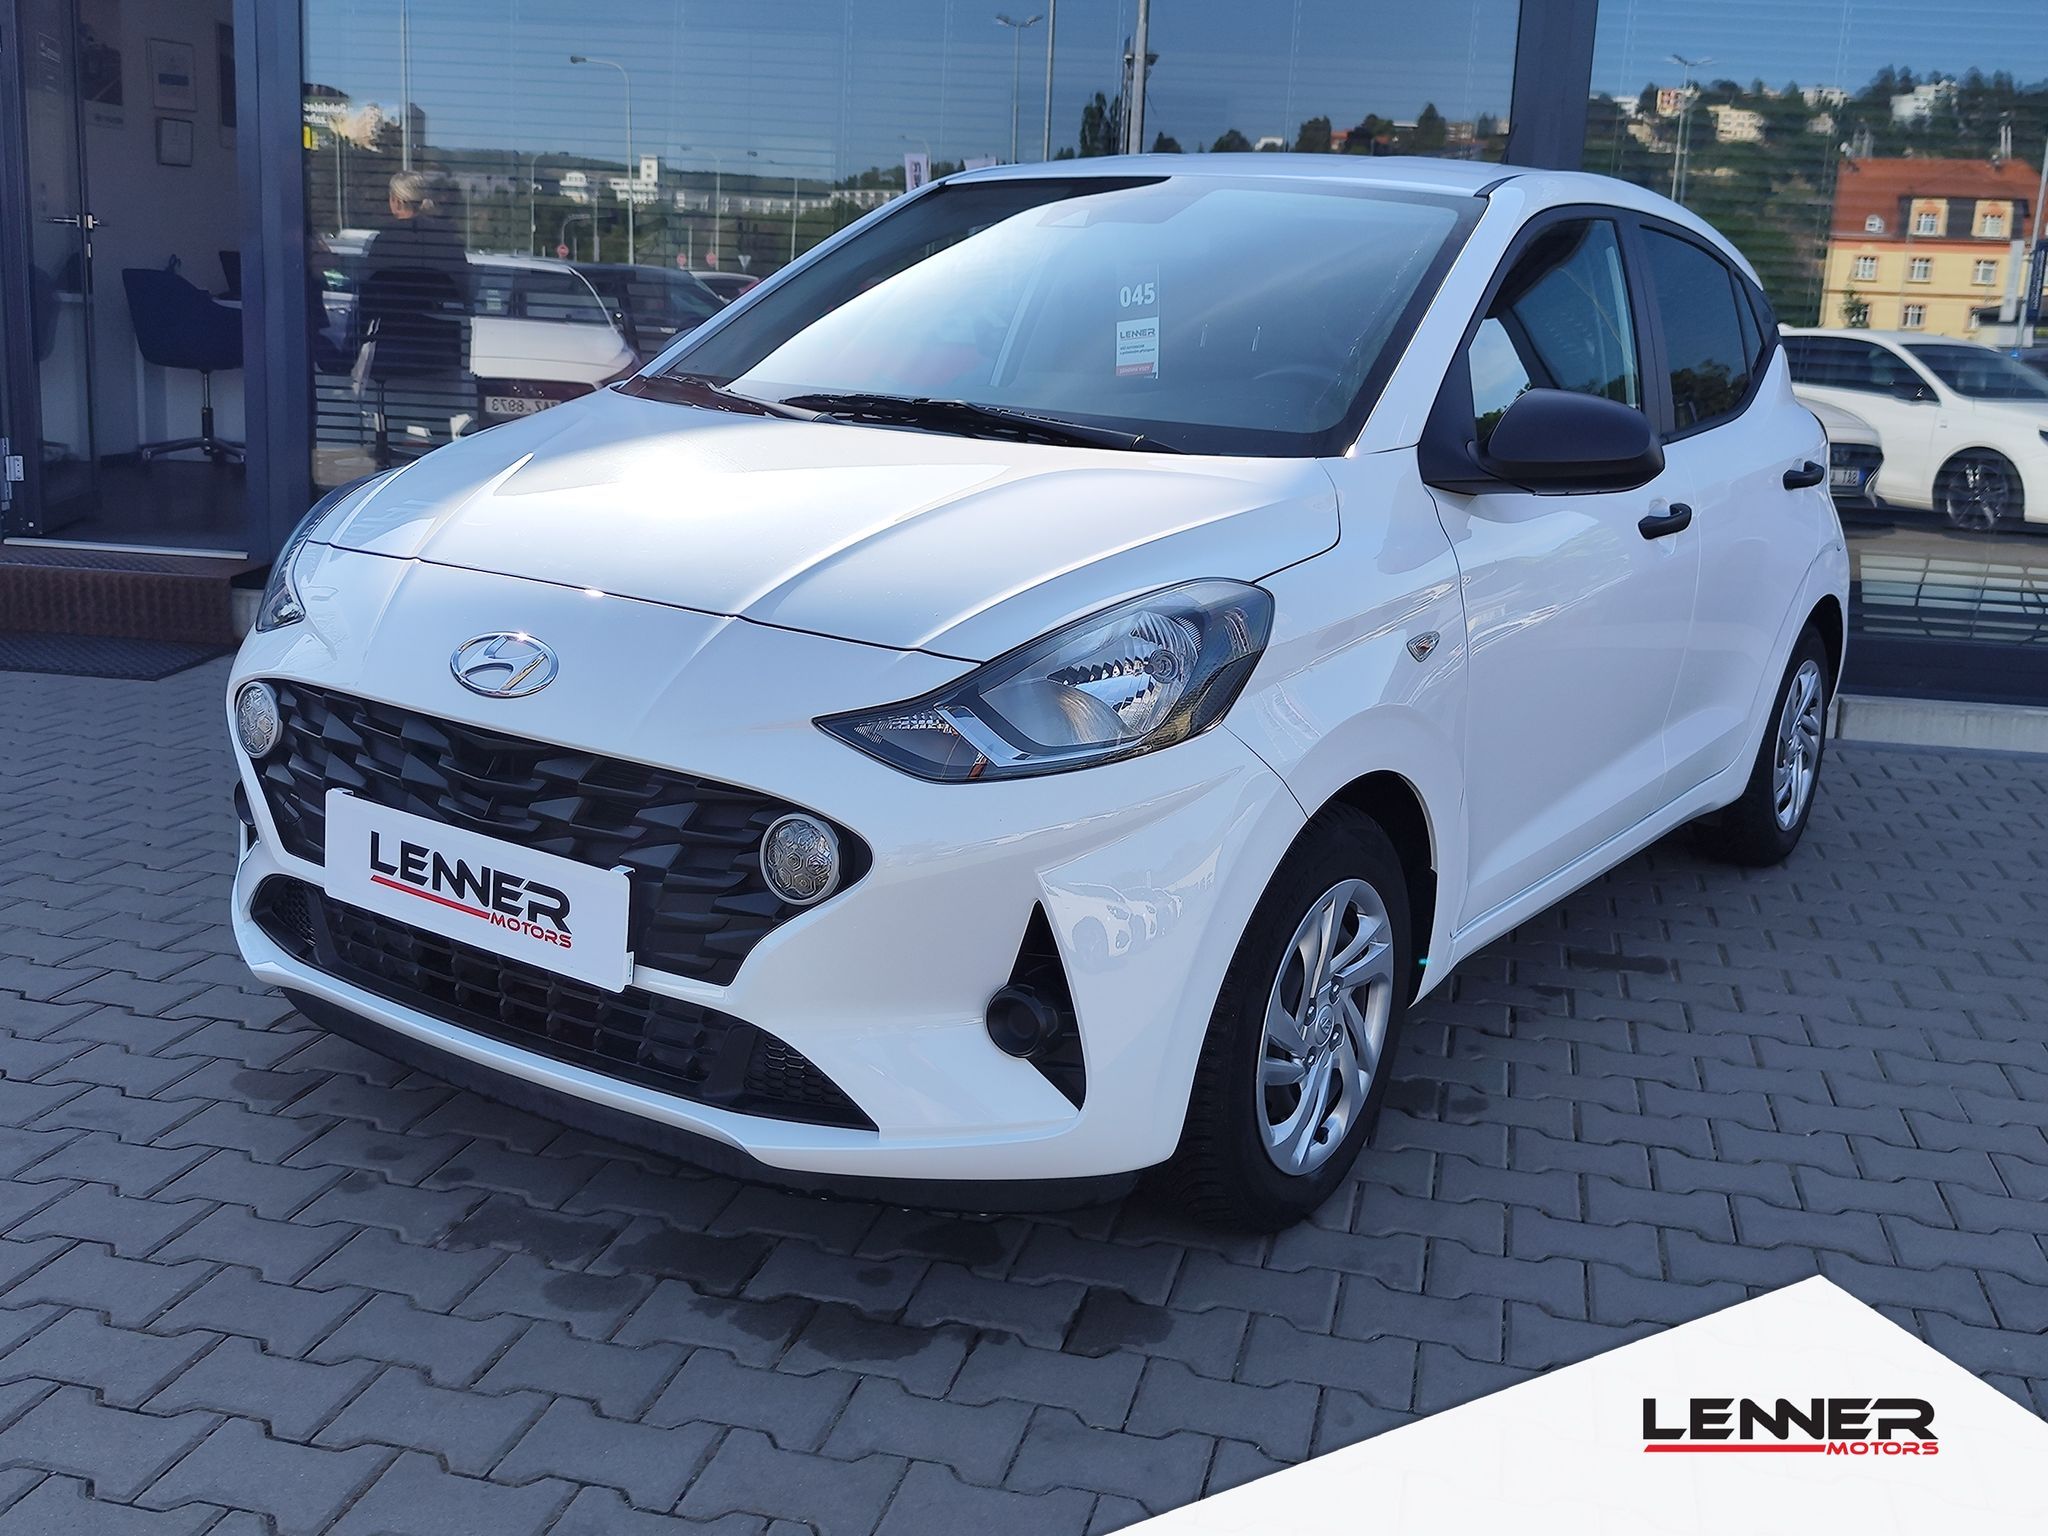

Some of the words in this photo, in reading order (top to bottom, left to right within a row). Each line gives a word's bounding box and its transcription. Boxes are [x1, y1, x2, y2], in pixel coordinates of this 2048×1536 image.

[1120, 282, 1155, 308] 045
[1120, 328, 1156, 339] LENNER
[370, 830, 573, 934] LENNER
[490, 911, 573, 949] MOTORS
